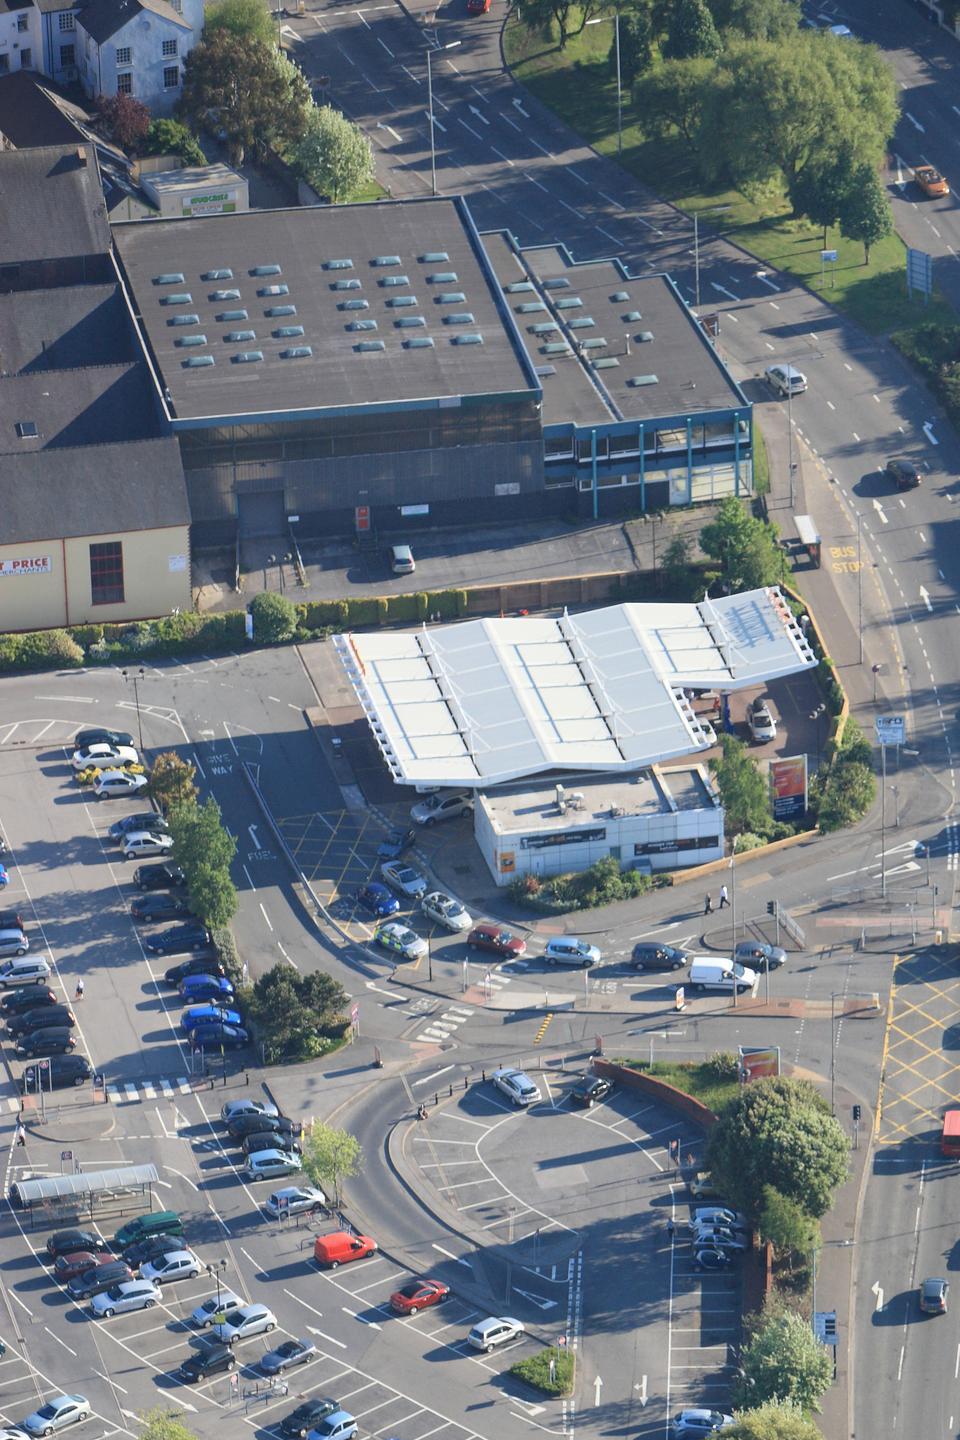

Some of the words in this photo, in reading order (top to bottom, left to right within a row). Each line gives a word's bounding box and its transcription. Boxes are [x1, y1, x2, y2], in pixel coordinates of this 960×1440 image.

[830, 546, 856, 558] BUS
[12, 557, 49, 569] PRICE
[832, 561, 864, 573] STOP
[211, 765, 233, 775] WAY
